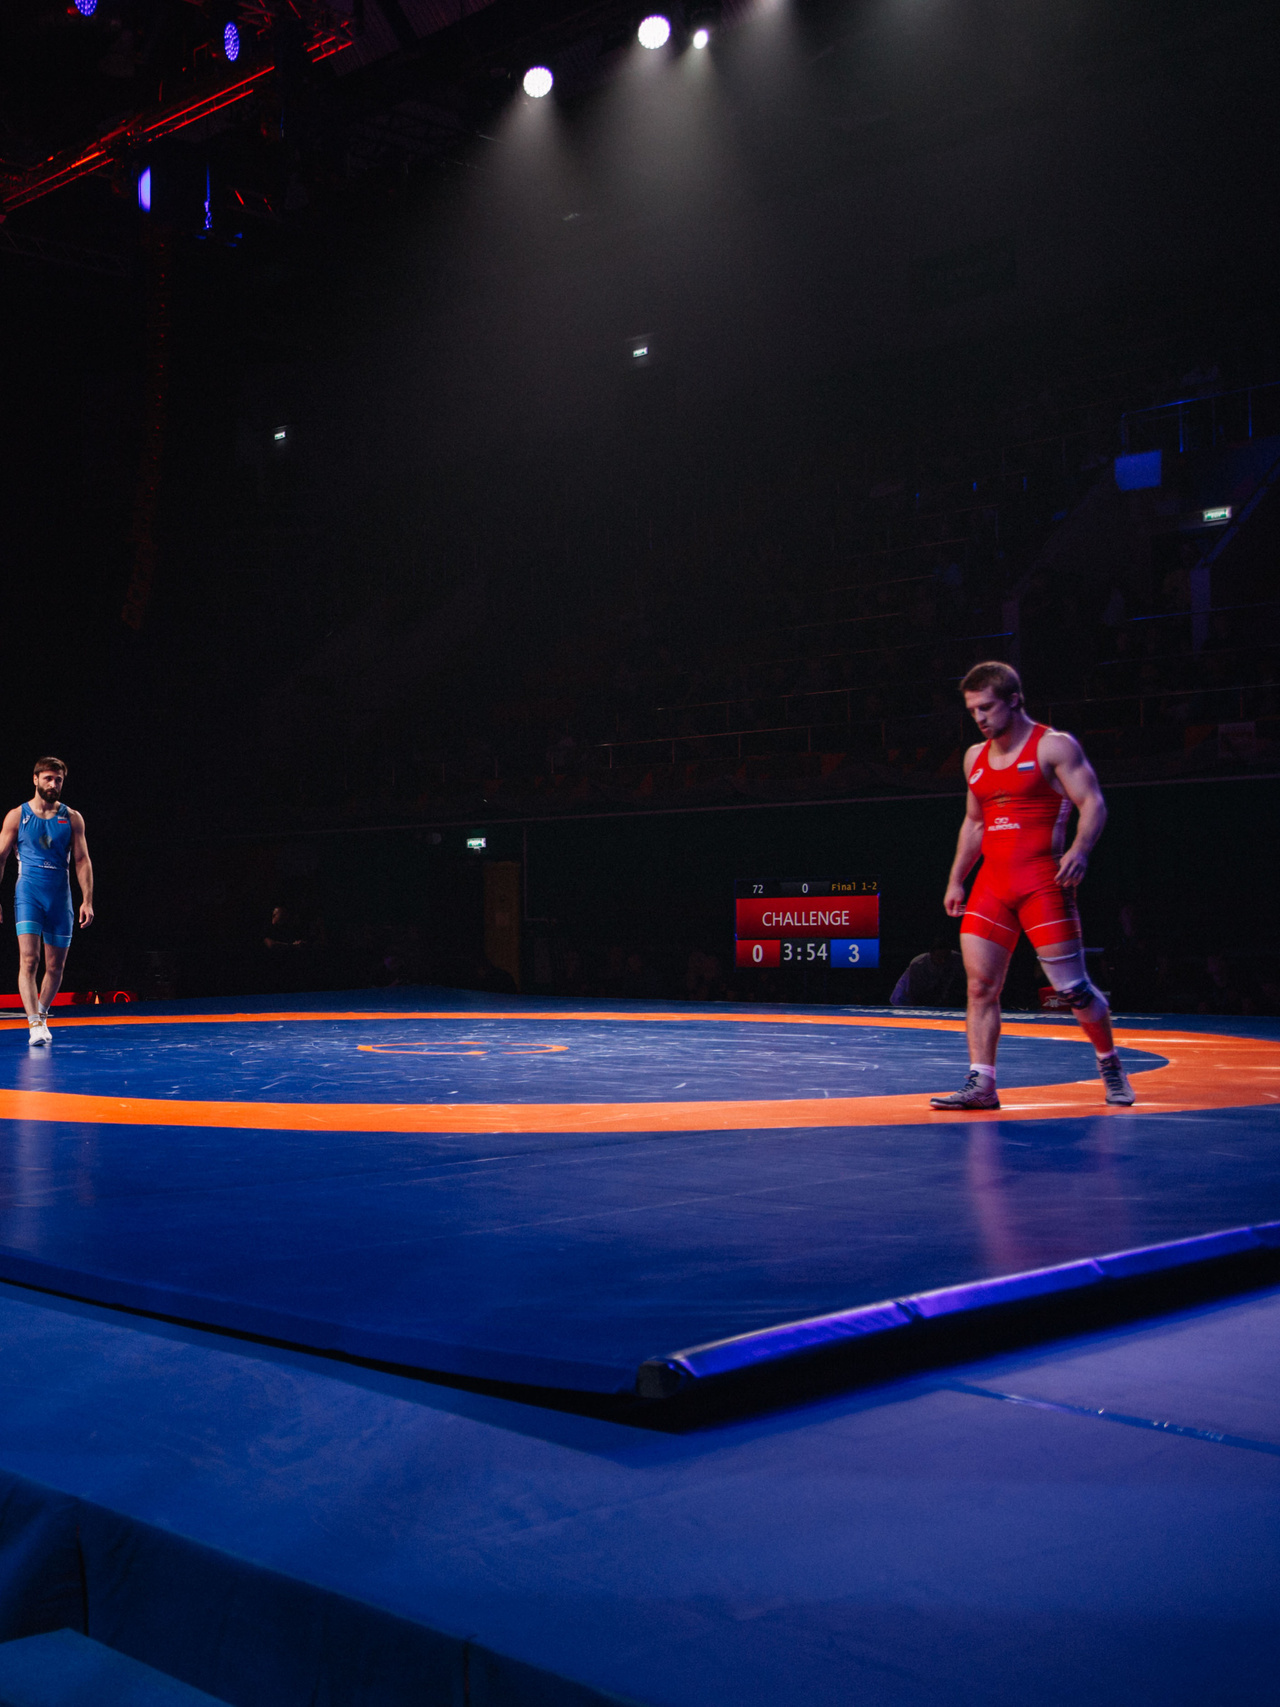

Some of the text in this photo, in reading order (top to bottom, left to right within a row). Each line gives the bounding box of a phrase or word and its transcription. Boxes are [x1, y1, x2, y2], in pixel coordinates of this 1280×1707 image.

[752, 882, 877, 894] 72 0 Final 1-2
[762, 910, 850, 926] CHALLENGE
[752, 943, 860, 963] 0 3:54 3
